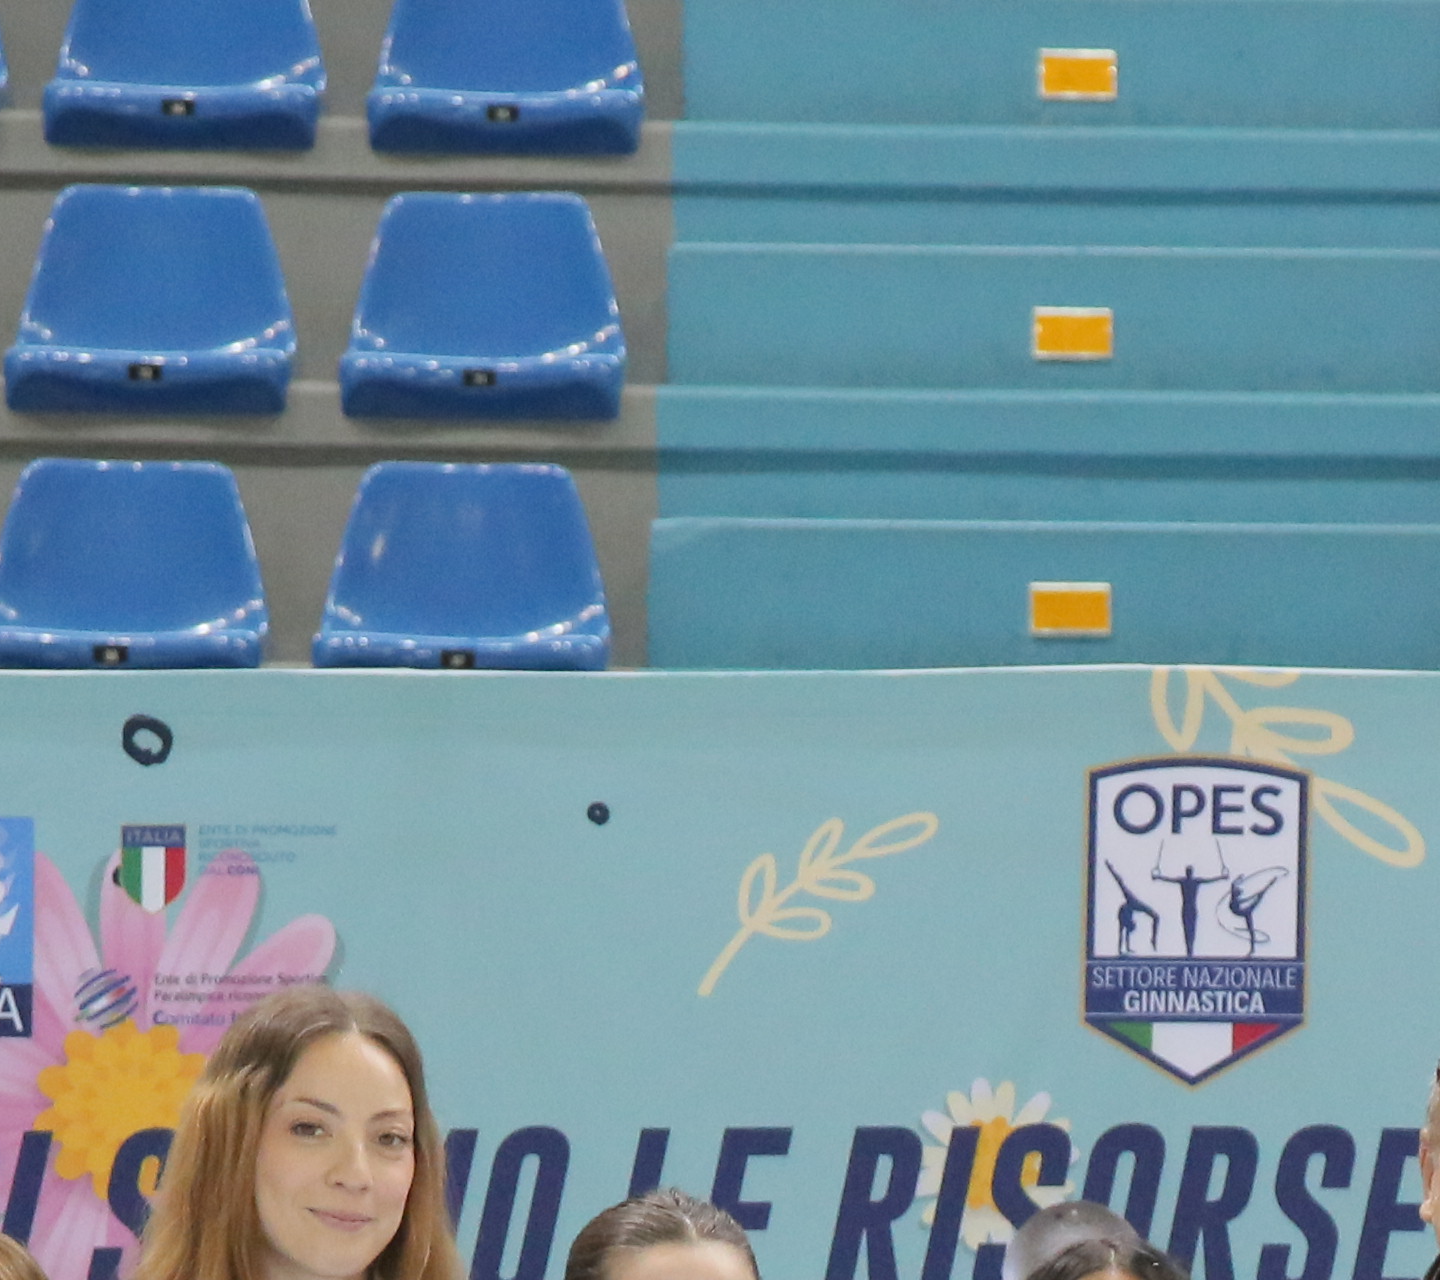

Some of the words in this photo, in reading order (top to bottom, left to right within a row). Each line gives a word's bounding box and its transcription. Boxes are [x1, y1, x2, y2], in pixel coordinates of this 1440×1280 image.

[1113, 782, 1285, 836] OPES
[127, 829, 184, 843] ITALIA
[154, 974, 181, 985] Ente
[186, 973, 198, 985] di
[201, 973, 273, 985] Promozione
[1092, 966, 1177, 987] SETTORE
[1182, 967, 1298, 989] NAZIONALE
[1124, 990, 1266, 1014] GINNASTICA
[153, 1010, 225, 1025] Comitato
